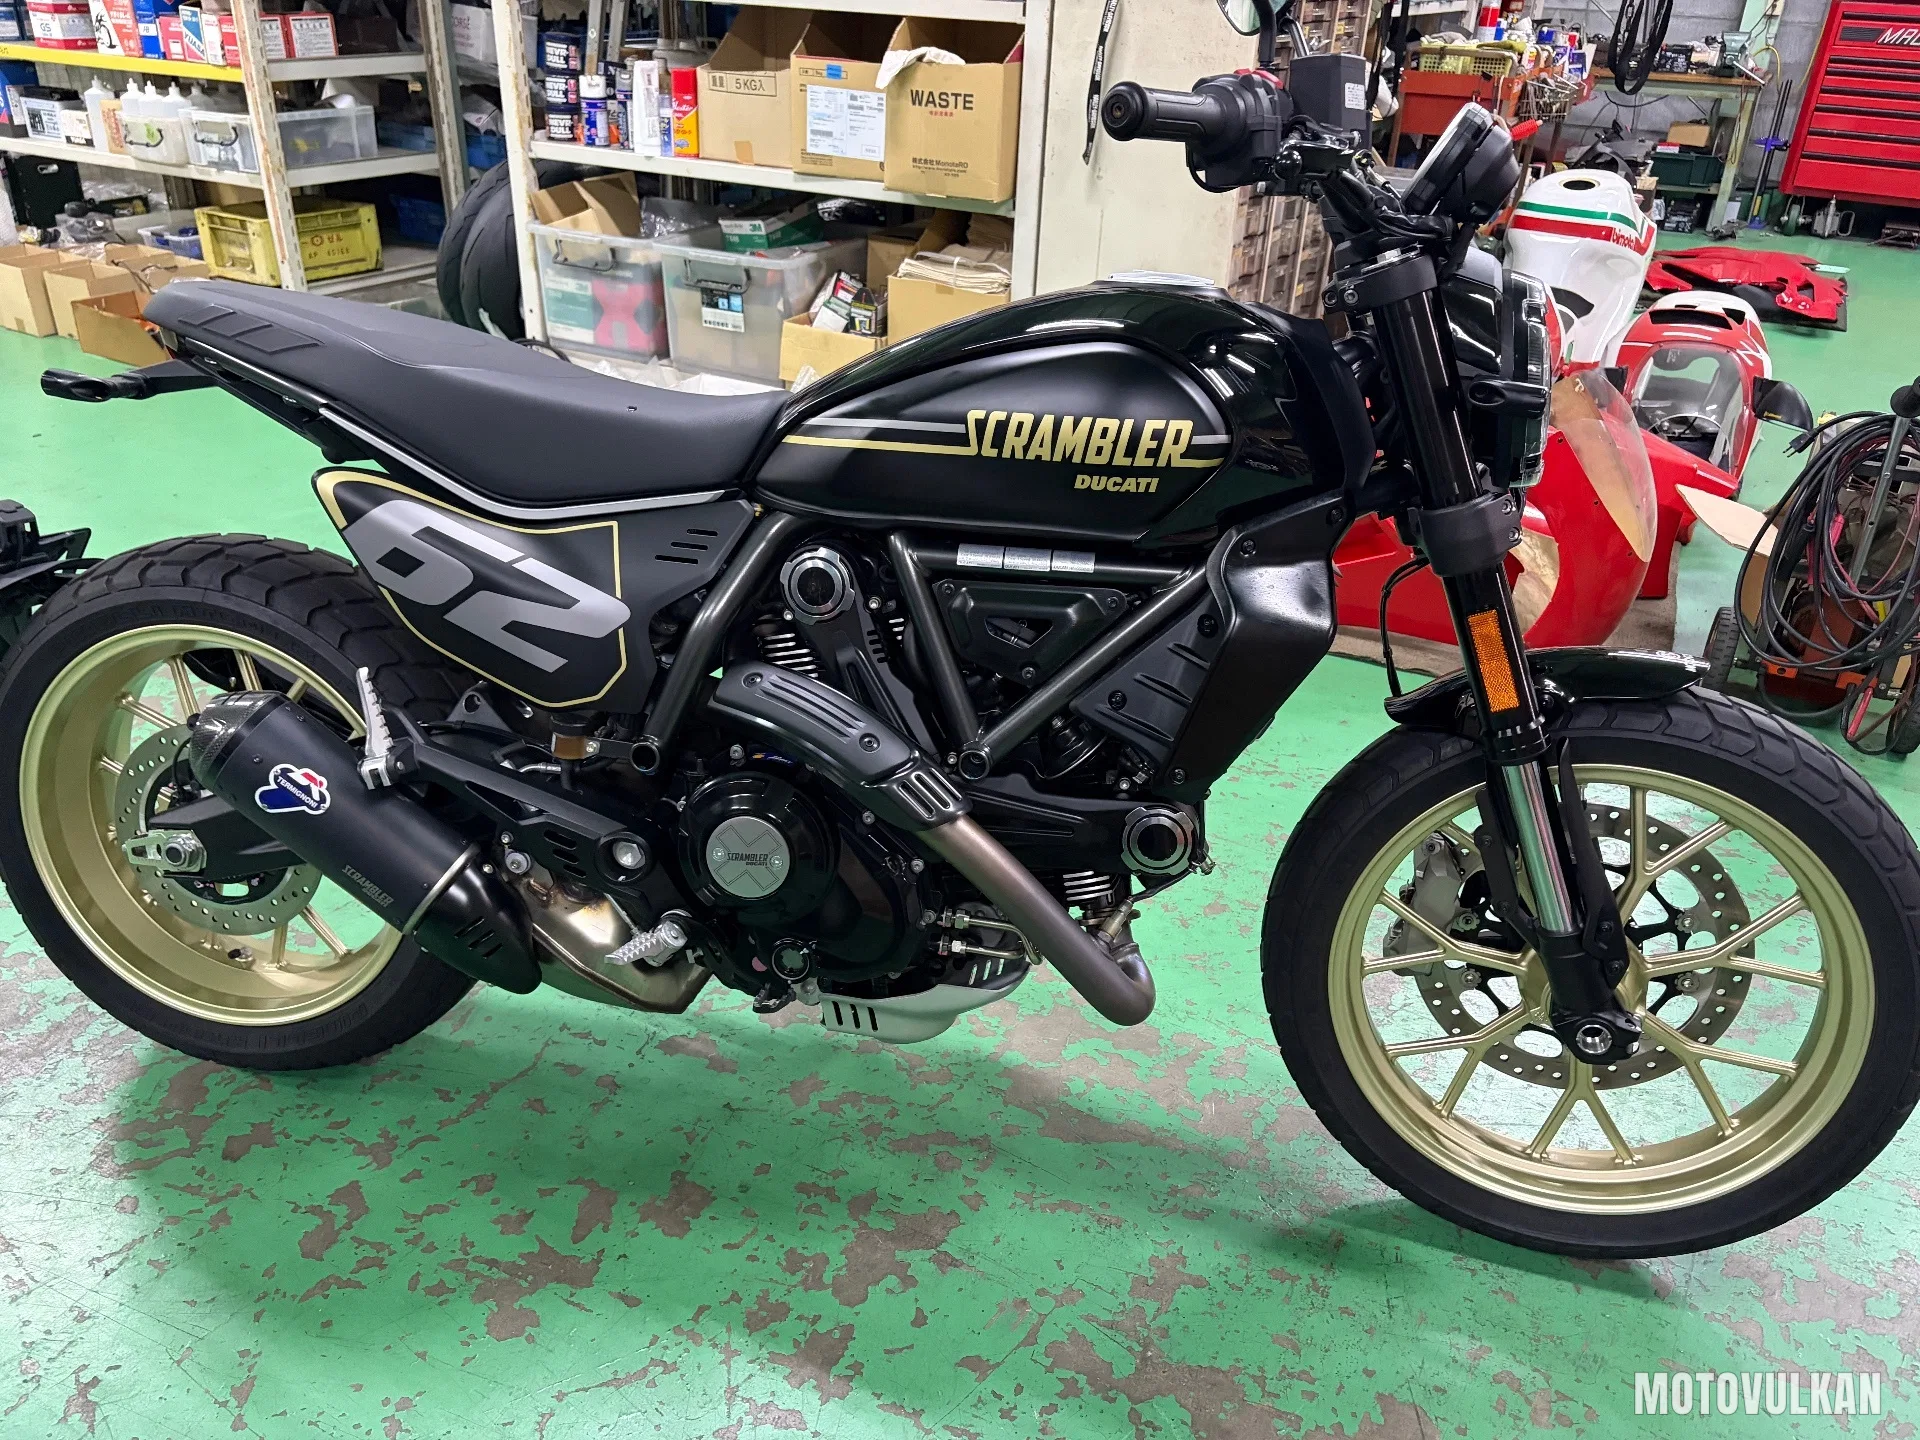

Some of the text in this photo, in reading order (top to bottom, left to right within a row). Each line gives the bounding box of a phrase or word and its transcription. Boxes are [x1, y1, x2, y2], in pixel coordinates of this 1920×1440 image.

[184, 31, 205, 56] YUASA
[910, 88, 974, 110] WASTE
[749, 223, 762, 232] 3M
[967, 409, 1195, 467] SCRAMBLER
[1074, 474, 1160, 493] DUCATI
[342, 500, 631, 673] 62
[276, 775, 319, 809] TERMIGNONI
[726, 852, 769, 862] SCRAMBLER
[341, 864, 395, 905] SCRAMBLER
